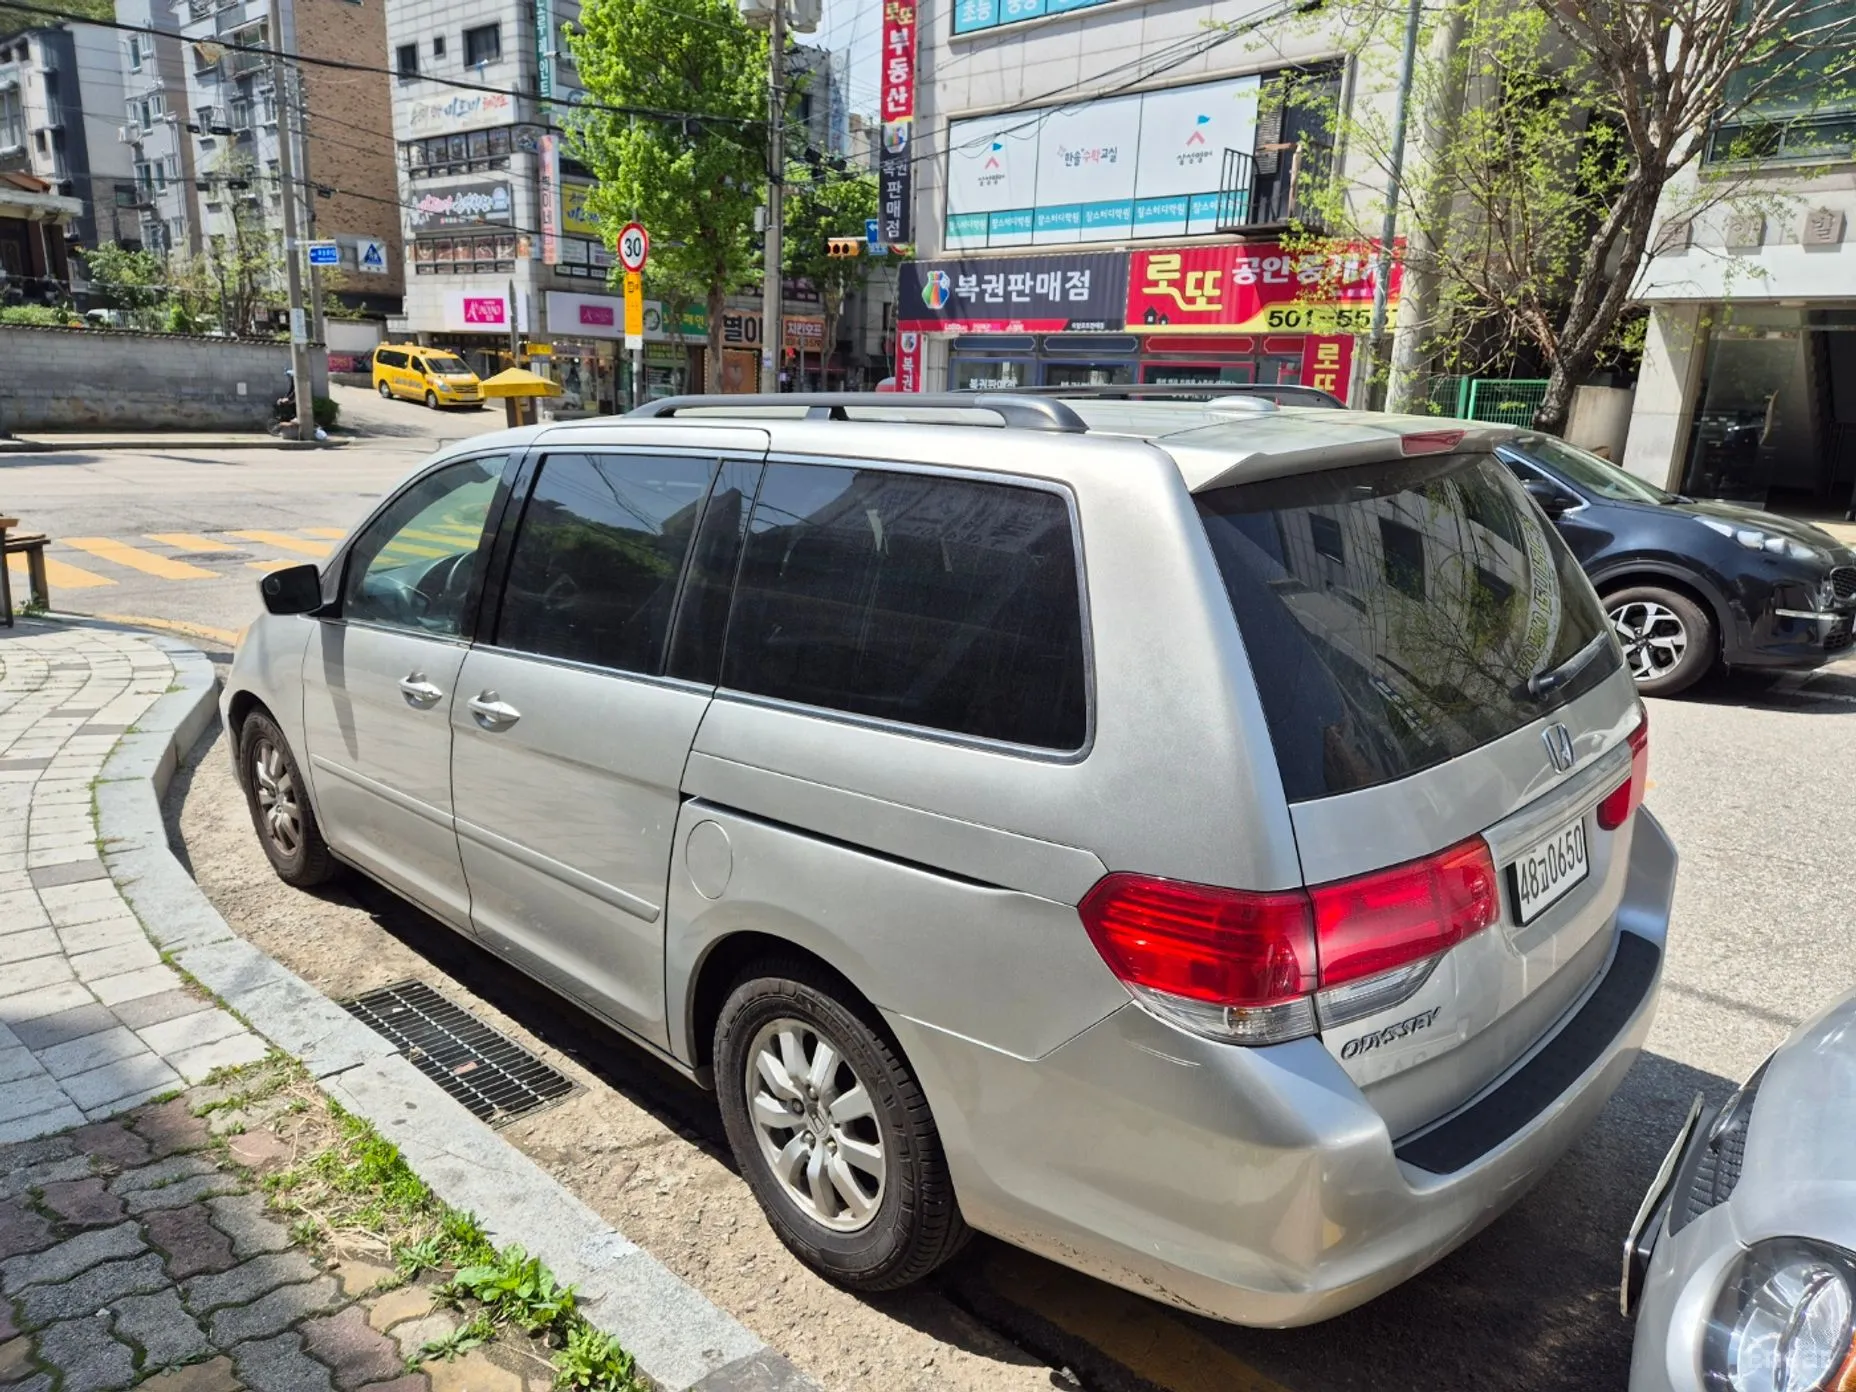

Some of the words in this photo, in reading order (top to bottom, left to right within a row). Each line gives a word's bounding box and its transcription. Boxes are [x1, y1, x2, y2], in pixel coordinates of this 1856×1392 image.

[885, 2, 914, 25] 로또
[887, 28, 910, 113] 부동산
[625, 237, 641, 257] 30
[955, 269, 1090, 303] 복권판매점
[1142, 254, 1223, 311] 로또
[1520, 825, 1583, 904] 48고0650
[1340, 1006, 1442, 1060] ODYSSEY
